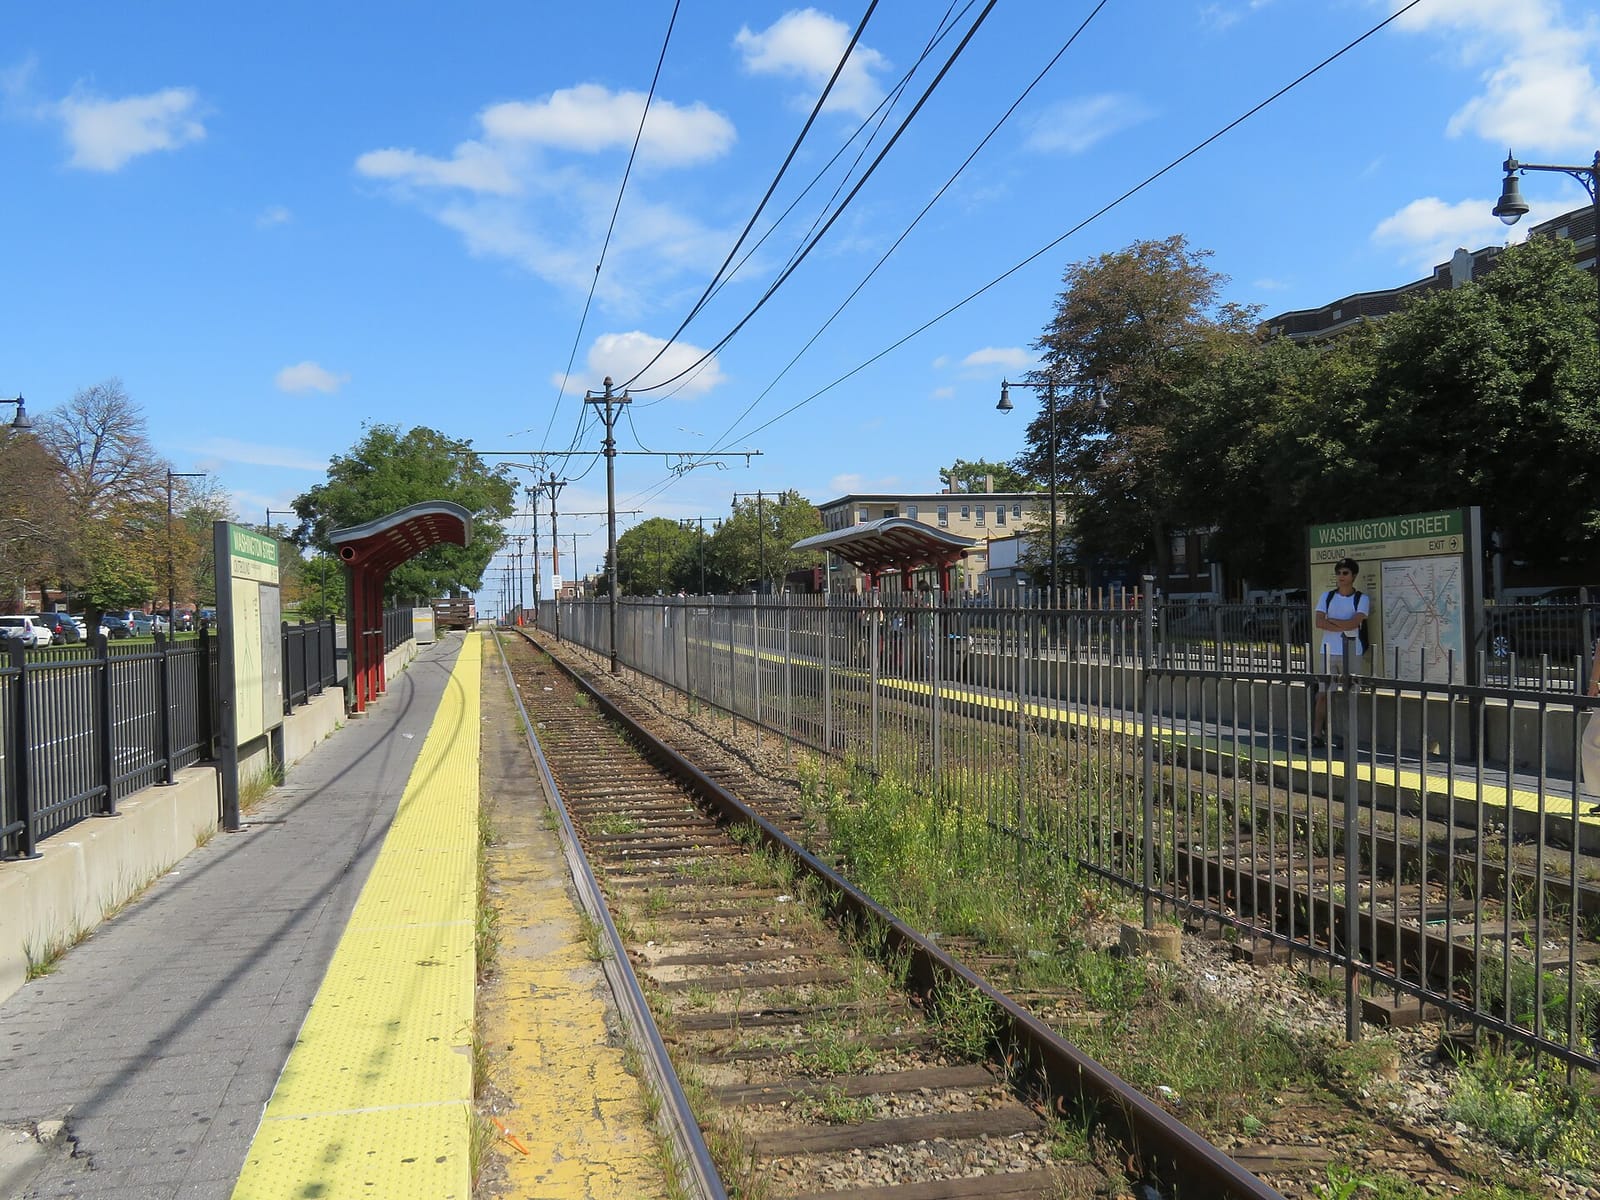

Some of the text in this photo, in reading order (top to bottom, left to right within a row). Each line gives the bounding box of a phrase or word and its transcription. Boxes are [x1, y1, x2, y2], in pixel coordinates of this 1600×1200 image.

[1319, 515, 1450, 544] WASHINGTON STREET
[233, 530, 275, 561] WASHINGTON STREET
[1316, 549, 1346, 561] INBOUND
[1429, 540, 1445, 551] EXIT
